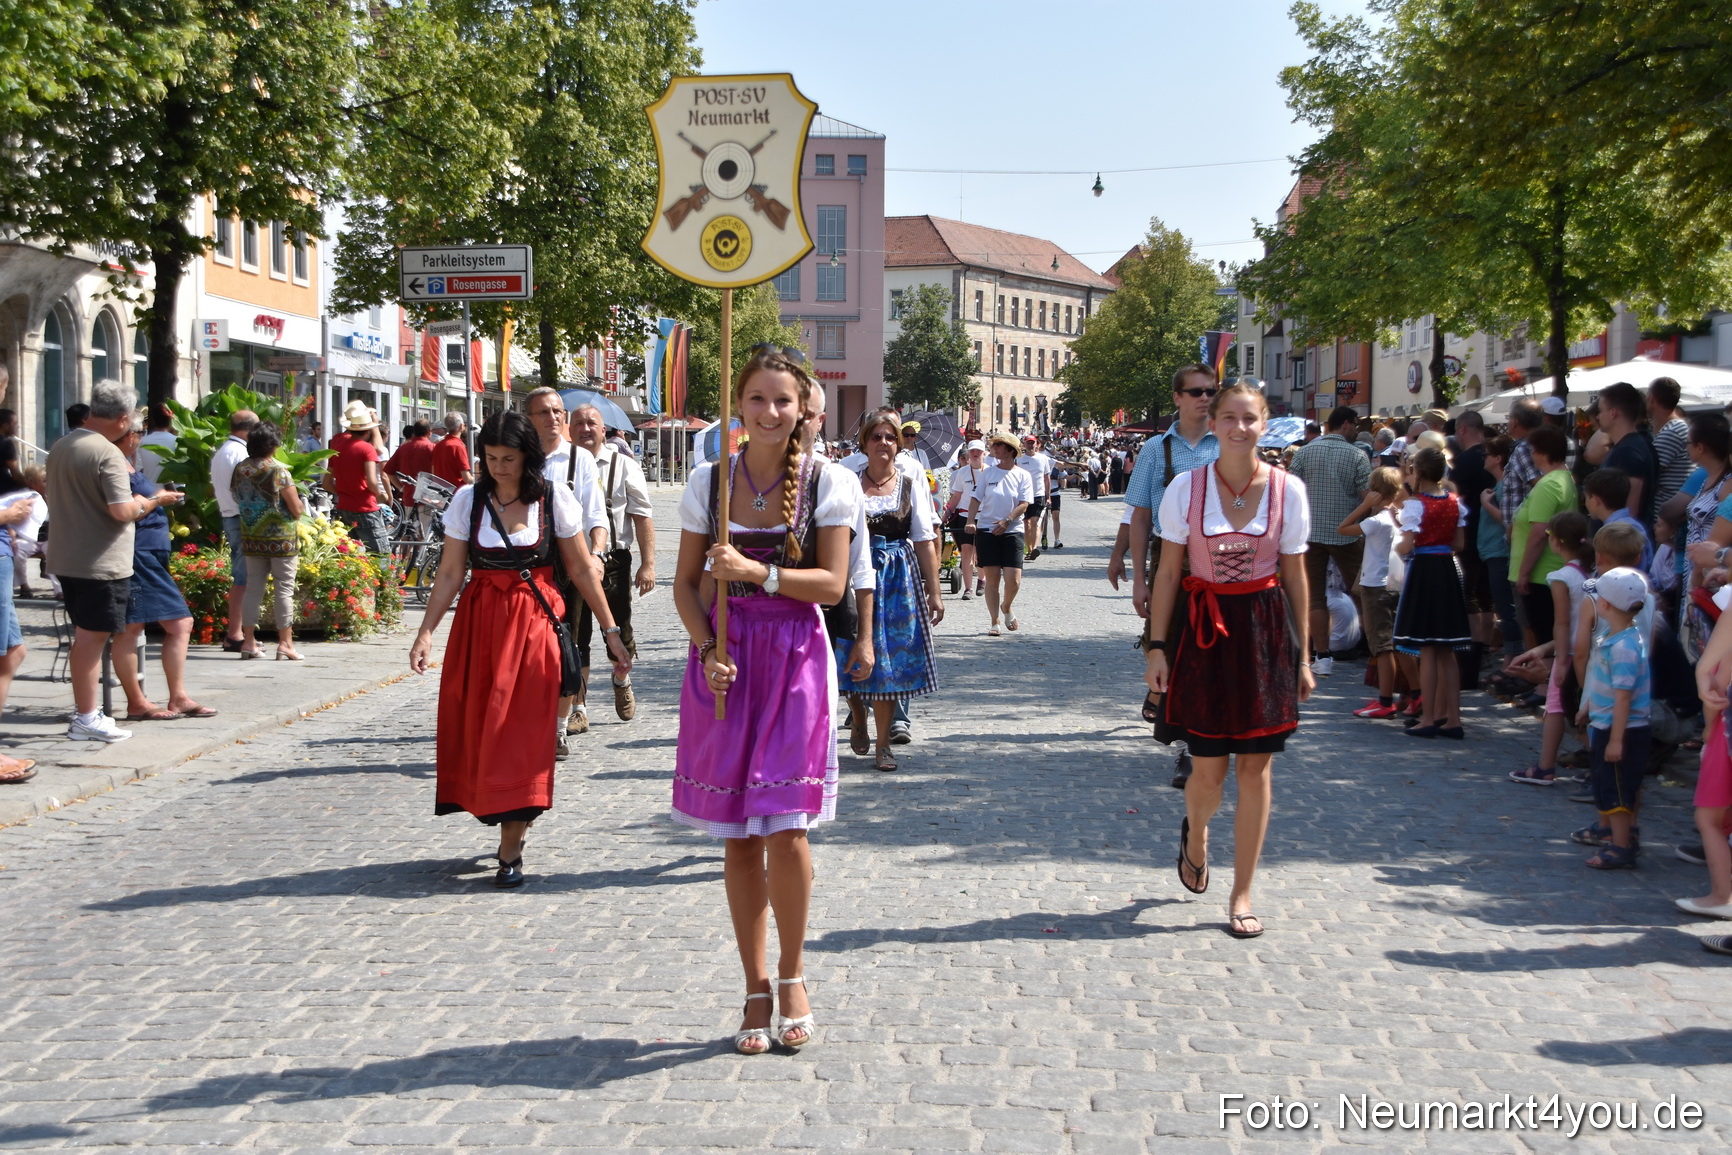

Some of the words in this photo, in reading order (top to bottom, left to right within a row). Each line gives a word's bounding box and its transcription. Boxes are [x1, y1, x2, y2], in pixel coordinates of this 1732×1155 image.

[687, 107, 770, 126] Neumarkt
[422, 253, 506, 270] Parkleitsystem
[453, 278, 507, 292] Rosengasse
[430, 324, 461, 335] Rosengasse
[814, 369, 847, 380] kasse
